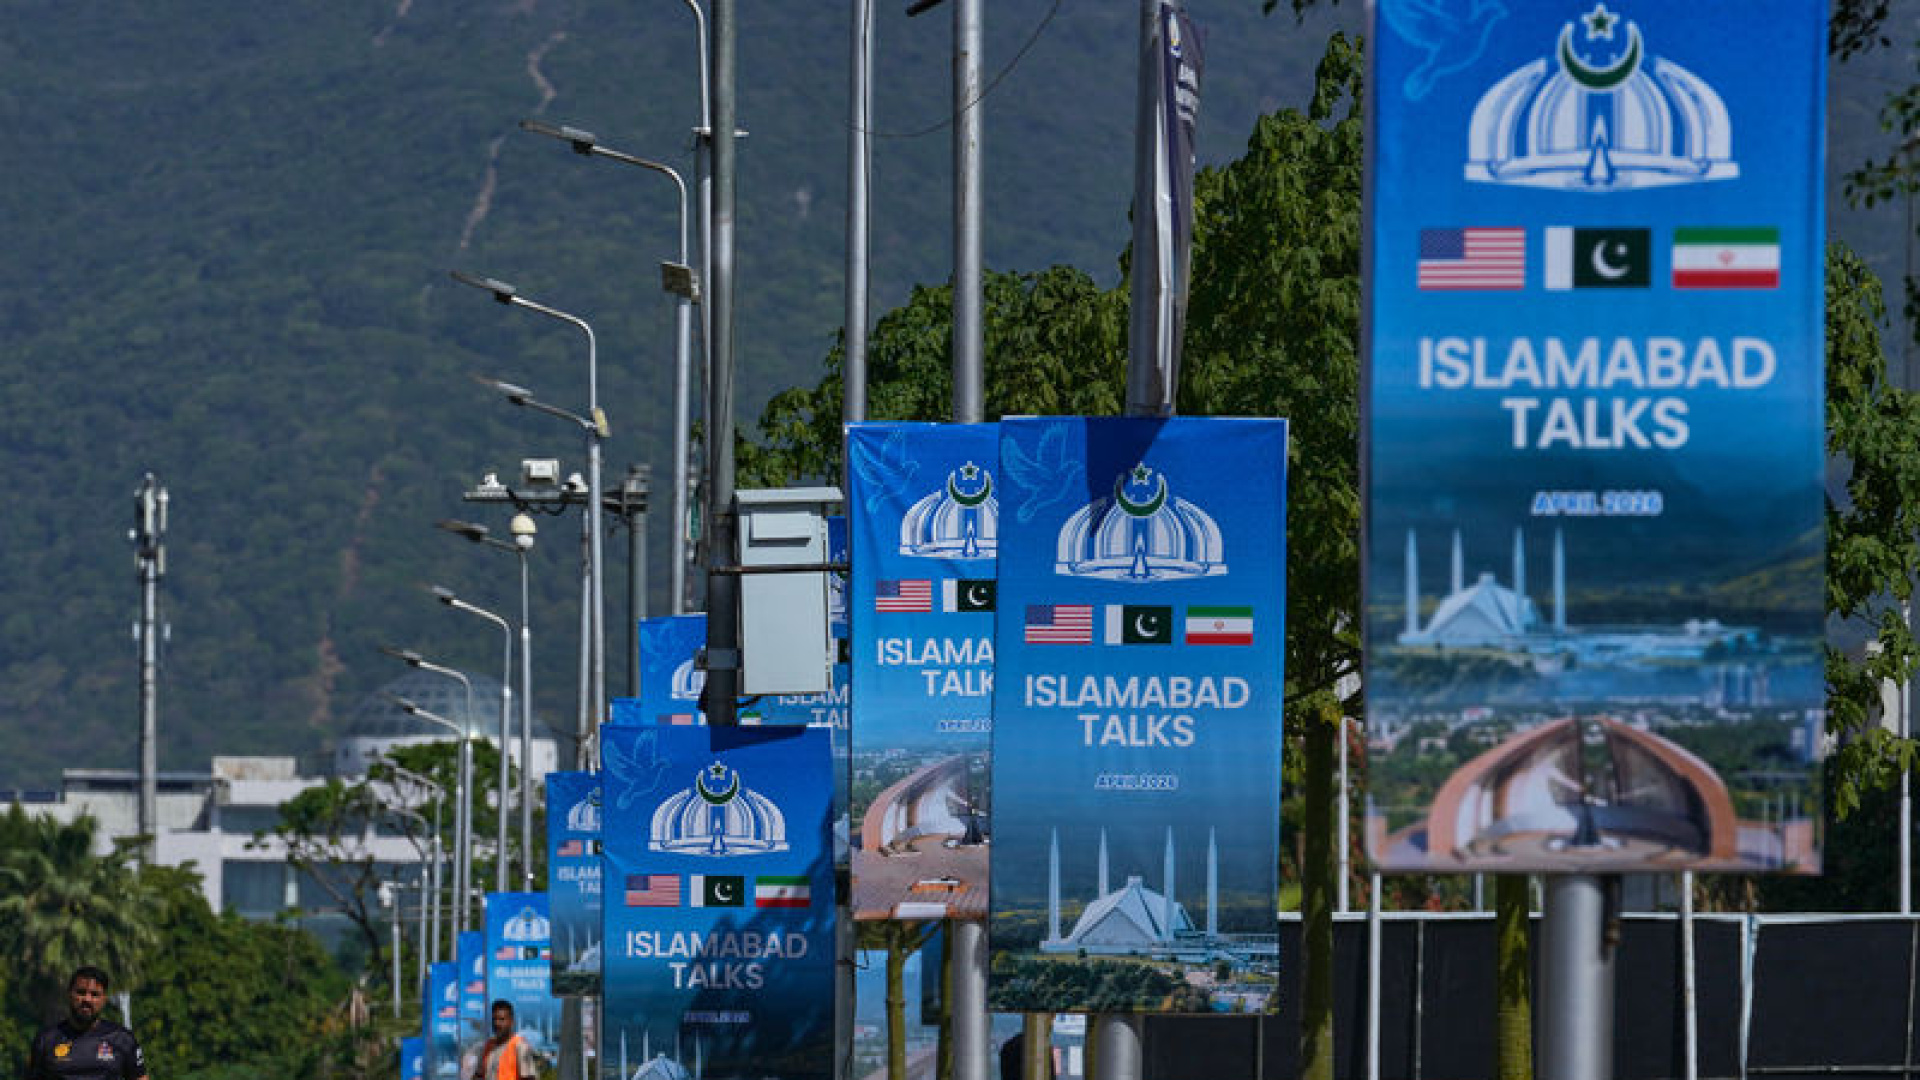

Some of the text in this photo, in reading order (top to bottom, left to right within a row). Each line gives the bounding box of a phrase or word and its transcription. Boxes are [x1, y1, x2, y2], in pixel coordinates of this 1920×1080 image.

[1419, 337, 1776, 388] ISLAMABAD
[1502, 397, 1690, 449] TALKS
[1531, 490, 1600, 516] APRIL
[1025, 674, 1250, 709] ISLAMABAD
[1078, 714, 1196, 747] TALKS
[626, 930, 808, 958] ISLAMABAD
[669, 962, 764, 989] TALKS
